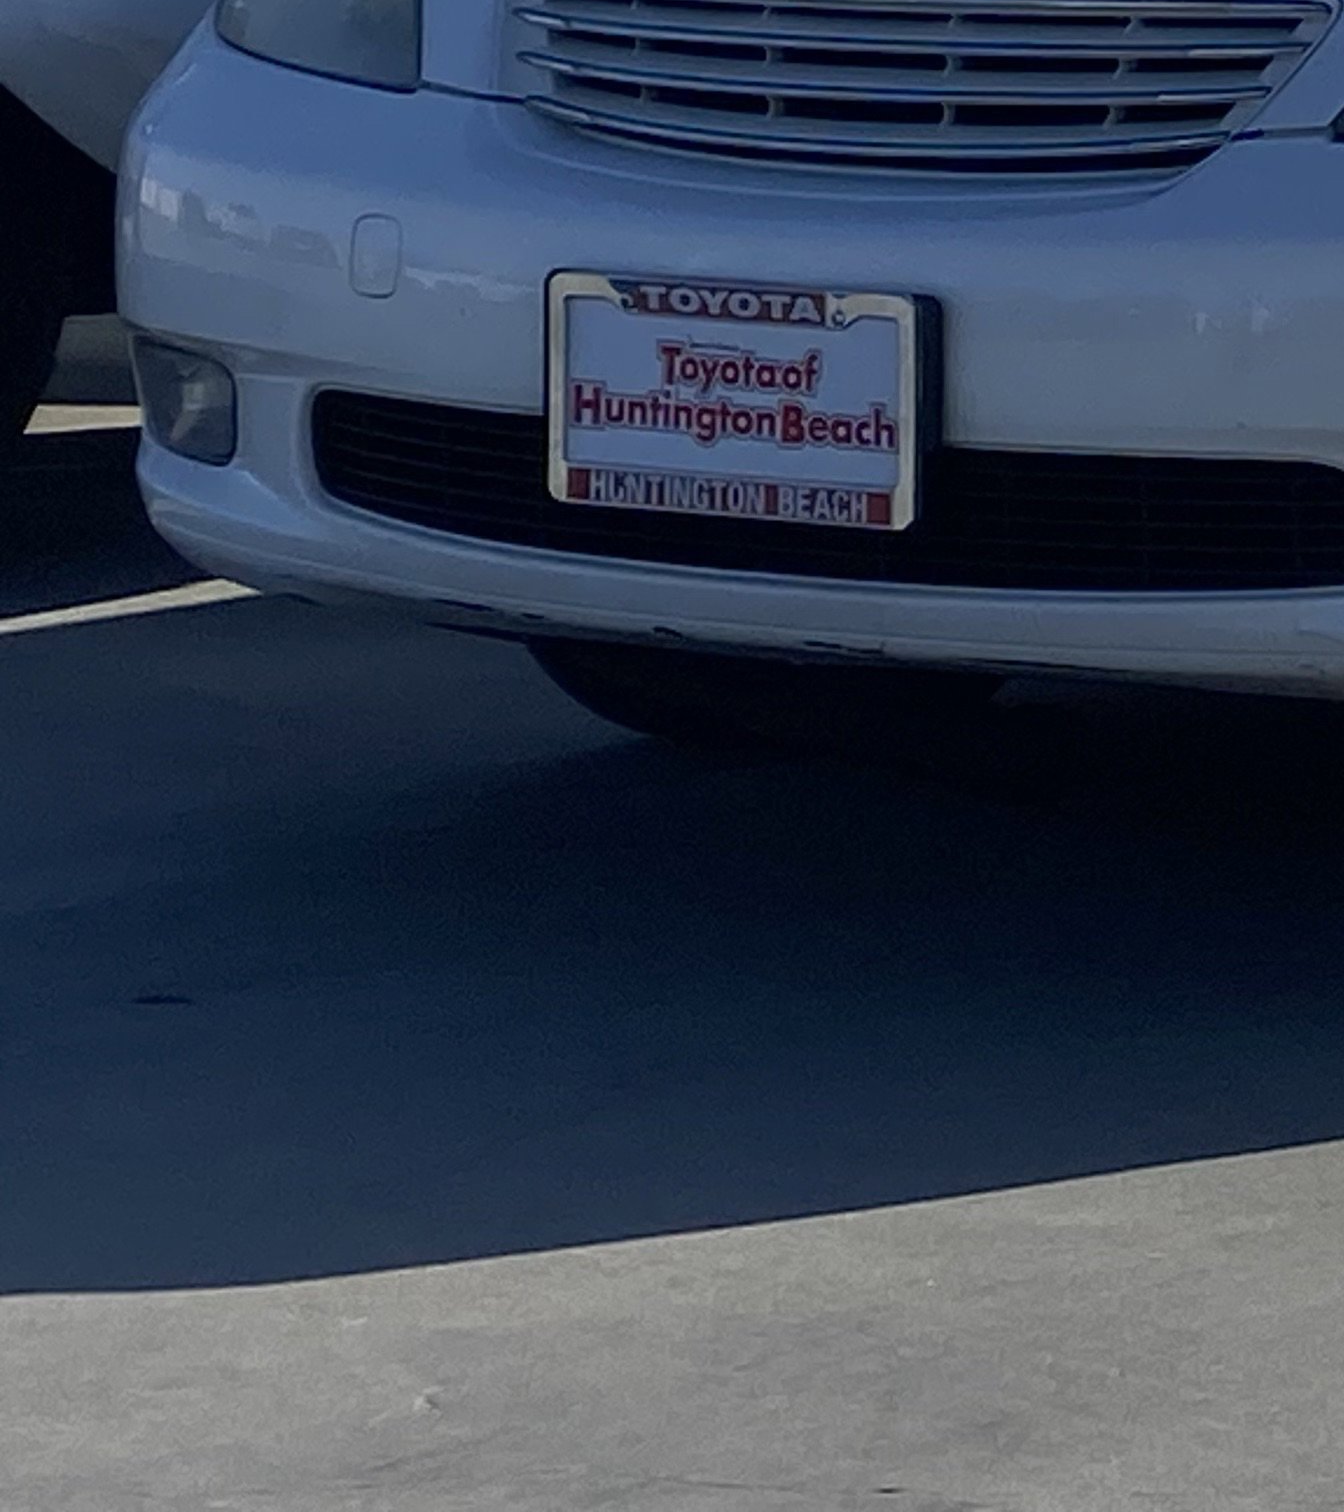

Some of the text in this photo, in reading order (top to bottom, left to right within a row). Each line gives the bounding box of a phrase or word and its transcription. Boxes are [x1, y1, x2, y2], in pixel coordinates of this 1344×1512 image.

[637, 285, 823, 324] TOYOTA
[659, 344, 820, 393] Toyota of
[572, 382, 896, 450] Huntington Beach
[589, 468, 868, 525] HUNTINGTON BEACH
